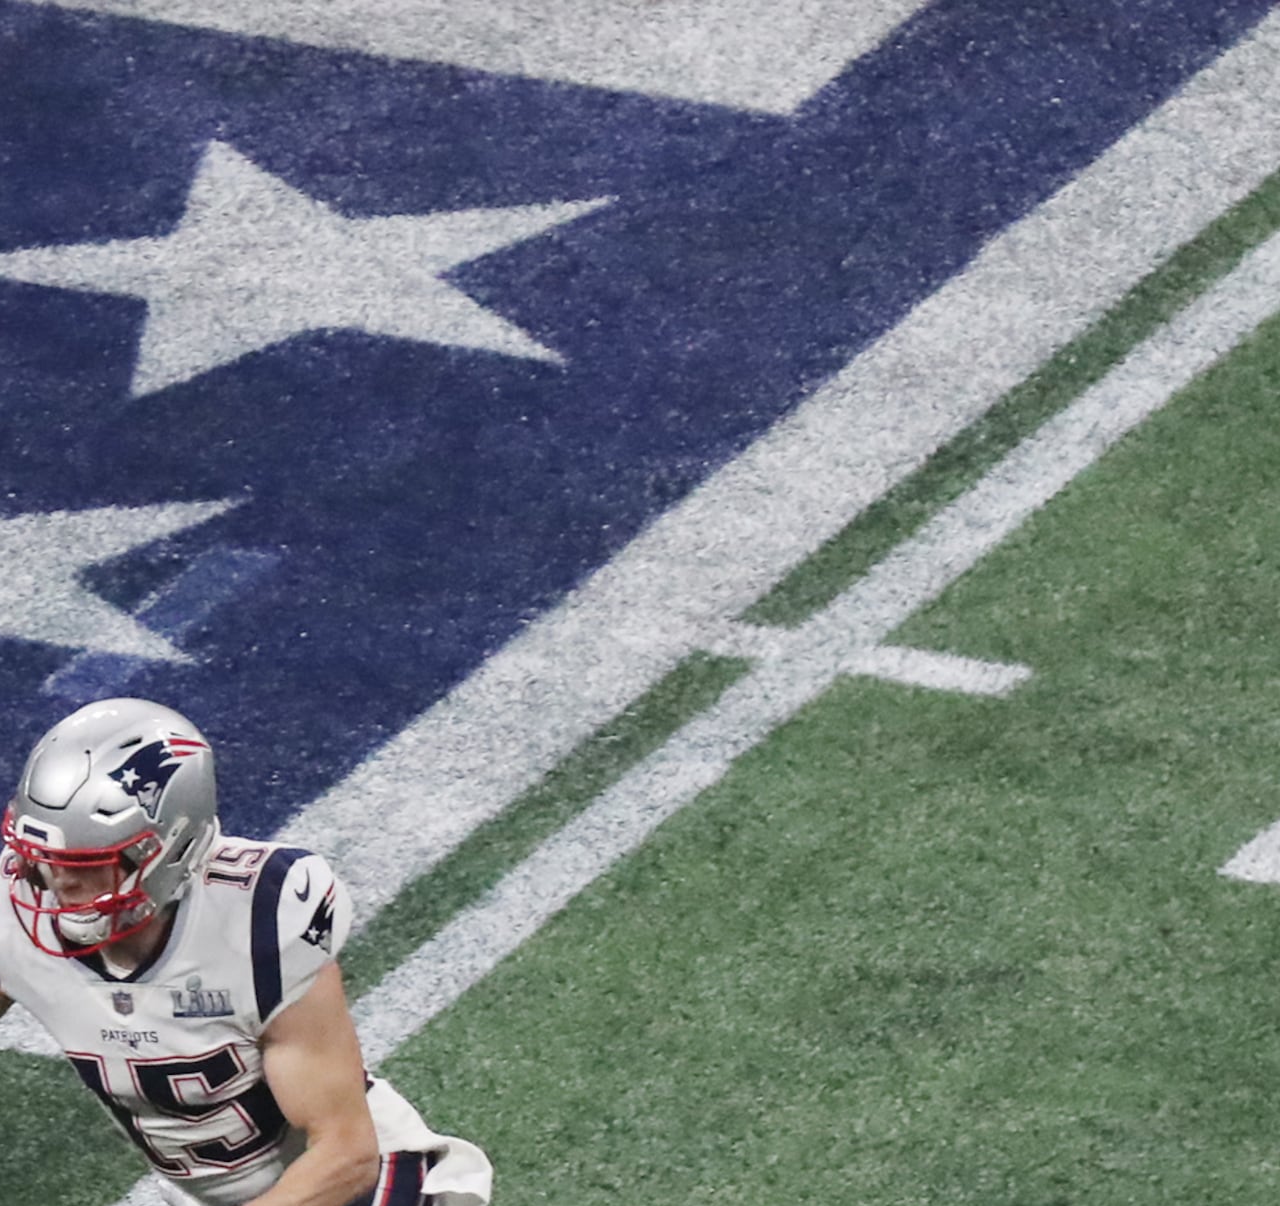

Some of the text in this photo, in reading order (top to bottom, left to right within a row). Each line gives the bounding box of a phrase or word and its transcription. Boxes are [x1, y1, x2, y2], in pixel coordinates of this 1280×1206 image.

[204, 845, 268, 891] 15
[100, 1029, 160, 1045] PATRIOTS
[64, 1042, 289, 1177] 15
